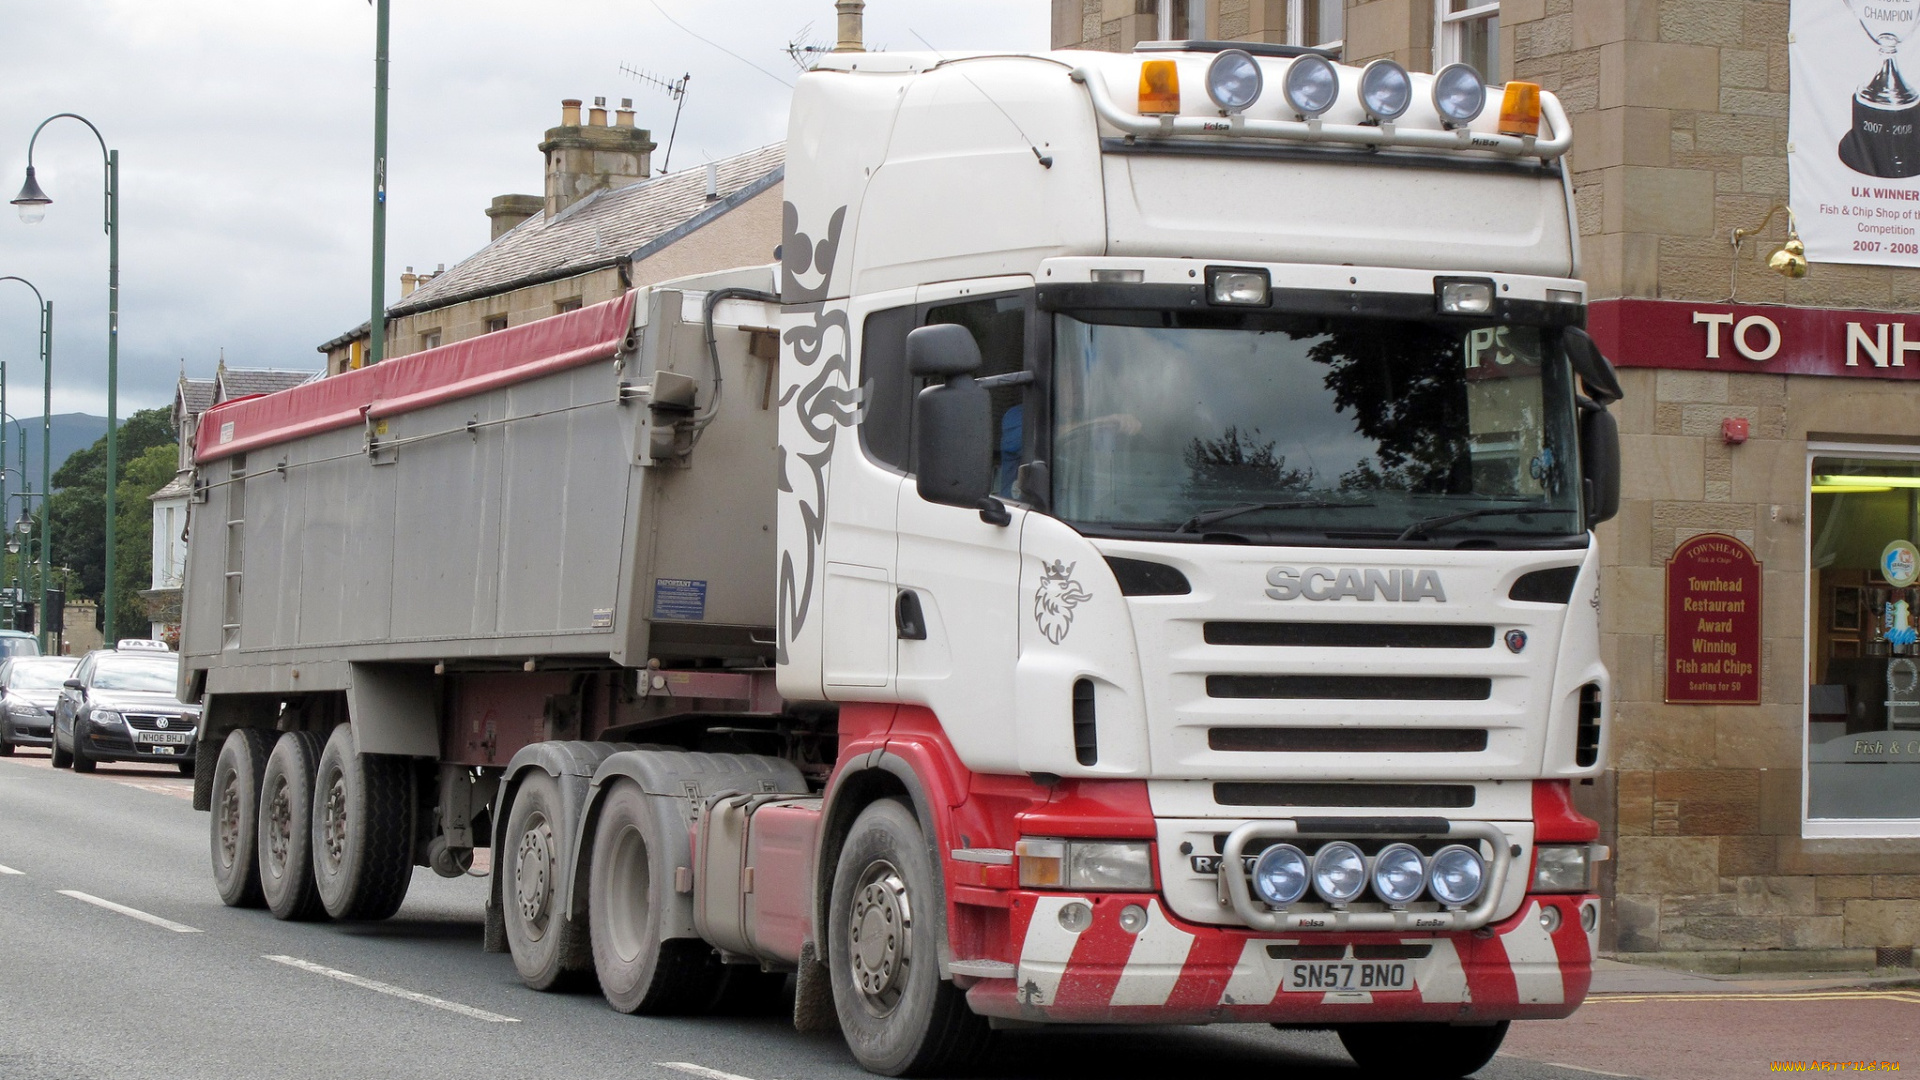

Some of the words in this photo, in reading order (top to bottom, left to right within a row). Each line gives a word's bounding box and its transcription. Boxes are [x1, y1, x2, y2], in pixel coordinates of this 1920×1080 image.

[1864, 5, 1913, 22] CHAMPION
[1863, 120, 1883, 133] 2007
[1892, 124, 1913, 135] 2008
[1851, 186, 1871, 198] U.K
[1873, 188, 1920, 201] WINNER
[1819, 203, 1839, 215] Fish
[1841, 205, 1850, 215] &
[1852, 206, 1874, 219] Chip
[1875, 207, 1900, 220] Shop
[1902, 209, 1912, 219] of
[1857, 222, 1915, 235] Competition
[1852, 240, 1881, 252] 2007
[1890, 242, 1919, 254] 2008
[1692, 310, 1782, 361] TO
[1686, 542, 1744, 559] TOWNHEAD
[1265, 565, 1447, 602] SCANIA
[1688, 576, 1743, 592] Townhead
[1684, 597, 1745, 613] Restaurant
[1697, 617, 1733, 633] Award
[123, 640, 163, 648] TAXI
[1692, 638, 1737, 655] Winning
[1676, 658, 1698, 674] Fish
[1700, 659, 1721, 674] and
[1723, 659, 1753, 677] Chips
[1689, 681, 1717, 692] Seating
[1718, 681, 1730, 691] for
[1731, 681, 1741, 691] 50
[166, 734, 182, 743] BHJ
[1853, 740, 1884, 754] Fish
[1889, 740, 1900, 754] &
[1416, 918, 1446, 927] EuroBar
[1292, 963, 1353, 989] SN57
[1360, 963, 1405, 988] BNO
